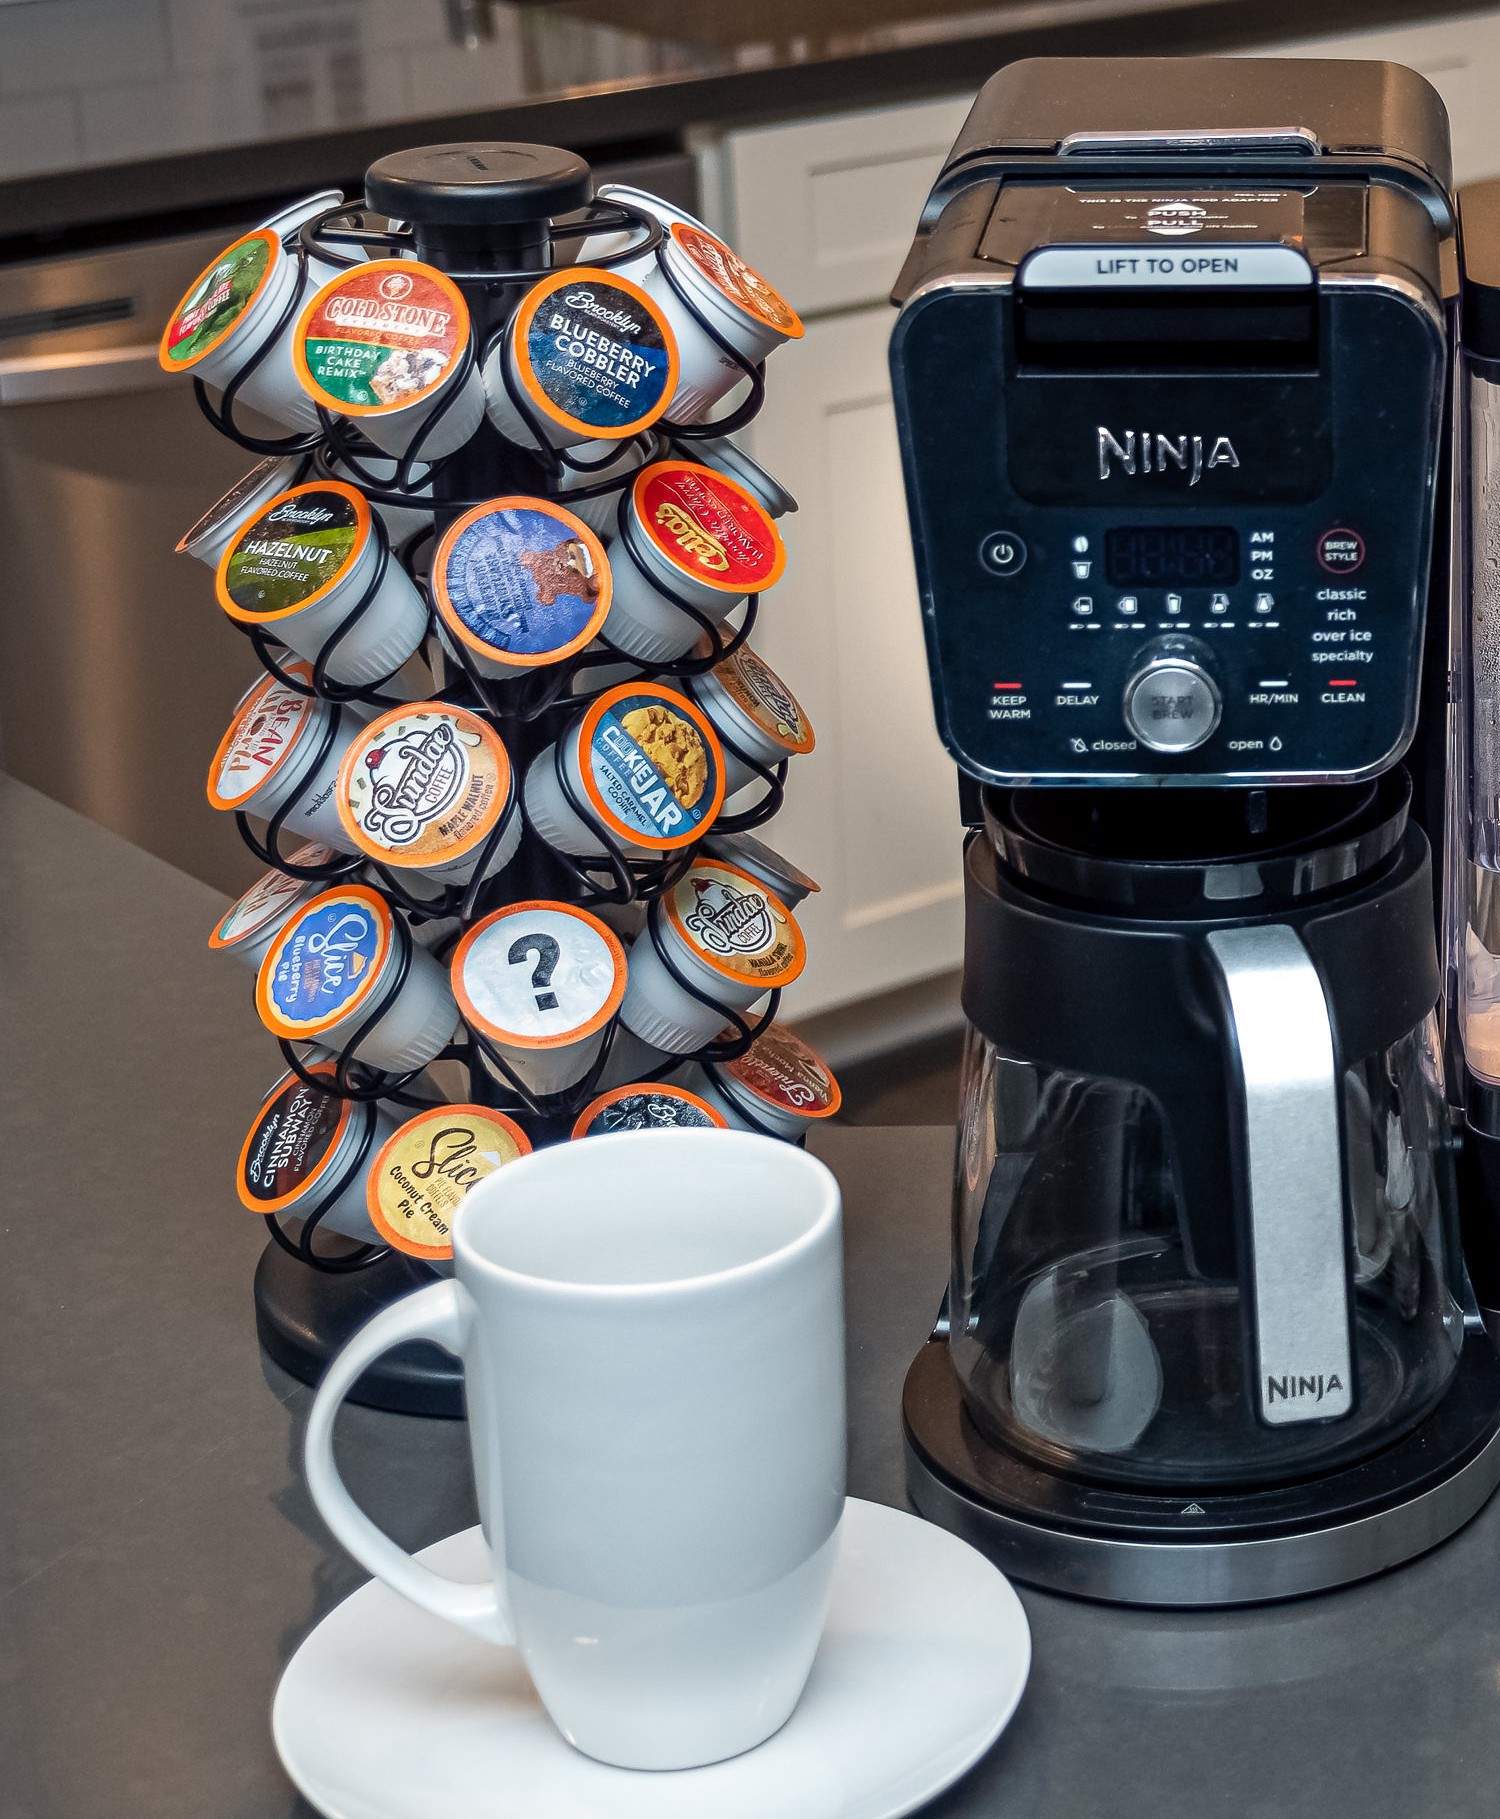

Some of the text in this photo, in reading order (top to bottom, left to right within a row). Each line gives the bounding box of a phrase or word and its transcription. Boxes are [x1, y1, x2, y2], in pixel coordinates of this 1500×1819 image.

[1097, 258, 1239, 274] LIFT TO OPEN
[325, 297, 379, 322] COLD
[378, 303, 452, 337] STONE
[566, 292, 642, 335] Brooklyn
[315, 345, 381, 361] BIRTHDAY
[550, 314, 656, 378] BLUEBERRY
[326, 356, 362, 369] CAKE
[555, 336, 641, 389] COBBLER
[567, 359, 620, 390] BLUEBERRY
[546, 360, 631, 409] FLAVORED COFFEE
[1098, 427, 1240, 486] NINJA
[268, 504, 334, 525] Brooklyn
[656, 502, 730, 572] Cella's
[1251, 532, 1274, 543] AM
[1325, 541, 1358, 550] BREW
[245, 540, 332, 565] HAZELNUT
[259, 558, 298, 570] HAZELNUT
[1251, 551, 1273, 562] PM
[1325, 552, 1358, 562] STYLE
[240, 566, 310, 582] FLAVORED COFFEE
[1252, 569, 1274, 580] OZ
[1316, 588, 1367, 600] classic
[1327, 608, 1356, 621] rich
[1312, 630, 1372, 642] over ice
[1312, 650, 1374, 664] specialty
[993, 696, 1026, 706] KEEP
[1056, 695, 1099, 706] DELAY
[1250, 694, 1298, 706] HR/MIN
[1321, 693, 1365, 703] CLEAN
[989, 709, 1031, 720] WARM
[1093, 740, 1137, 751] closed
[1228, 740, 1264, 752] open
[596, 738, 634, 779] COFFEE
[364, 723, 454, 843] Sundae
[425, 766, 454, 804] COFFEE
[600, 764, 648, 827] SALTED CARAMEL
[438, 774, 484, 837] MAPLE WALNUT
[608, 786, 633, 816] COOKIE
[686, 888, 765, 953] Sundae
[738, 922, 764, 944] COFFEE
[308, 914, 368, 994] Slice
[748, 953, 776, 969] VANILLA
[278, 962, 290, 982] Pie
[286, 936, 306, 1003] Blueberry
[508, 933, 560, 1012] ?
[796, 1071, 829, 1102] Vienna
[264, 1086, 310, 1188] CINNAMON
[278, 1099, 313, 1168] SUBWAY
[293, 1108, 317, 1156] CINNAMON
[250, 1114, 280, 1183] Brooklyn
[294, 1126, 316, 1172] FLAVORED
[390, 1165, 449, 1236] Coconut Cream
[397, 1199, 415, 1220] Pie
[1268, 1374, 1344, 1404] NINJA
